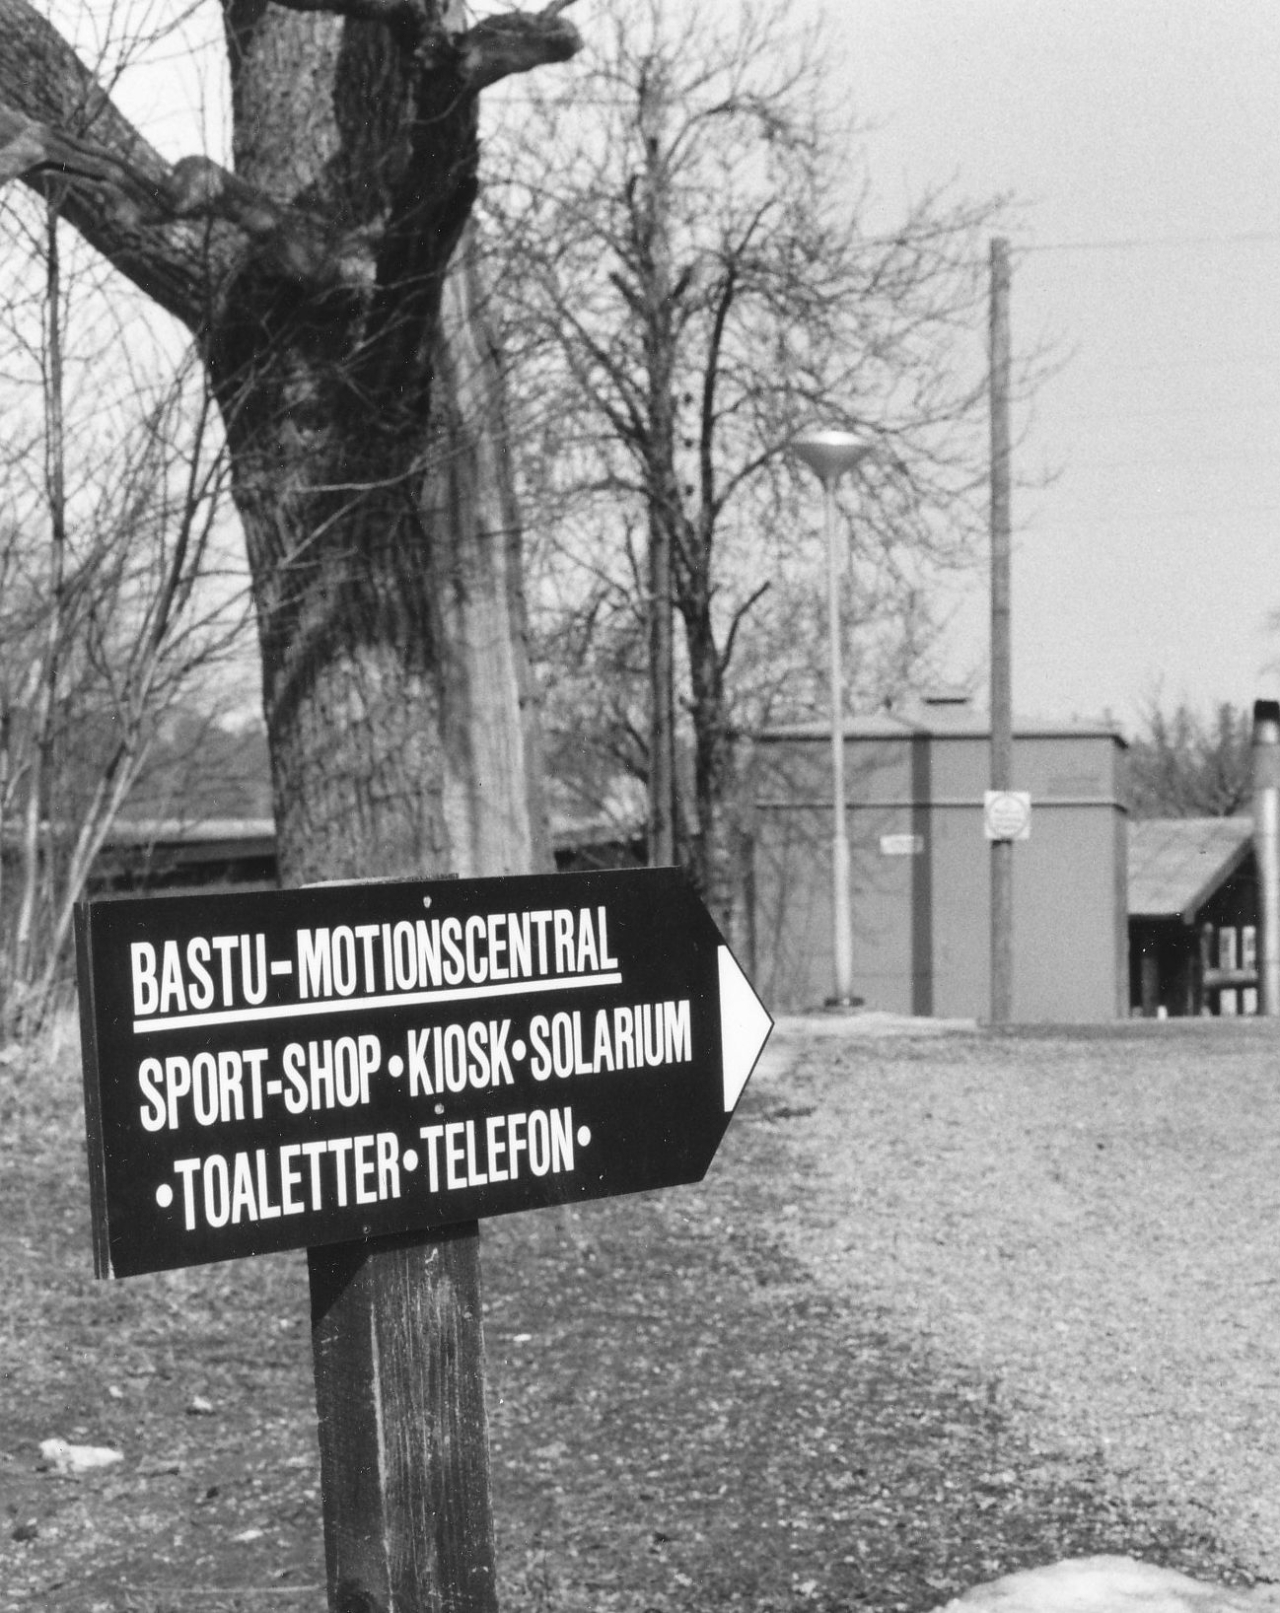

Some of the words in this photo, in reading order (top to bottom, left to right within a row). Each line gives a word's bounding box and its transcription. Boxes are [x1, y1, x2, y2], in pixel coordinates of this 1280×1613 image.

[138, 1034, 382, 1132] SPORT-SHOP
[407, 1018, 515, 1097] KIOSK
[529, 999, 692, 1081] SOLARIUM
[173, 1132, 401, 1231] TOALETTER
[419, 1106, 575, 1193] TELEFON
